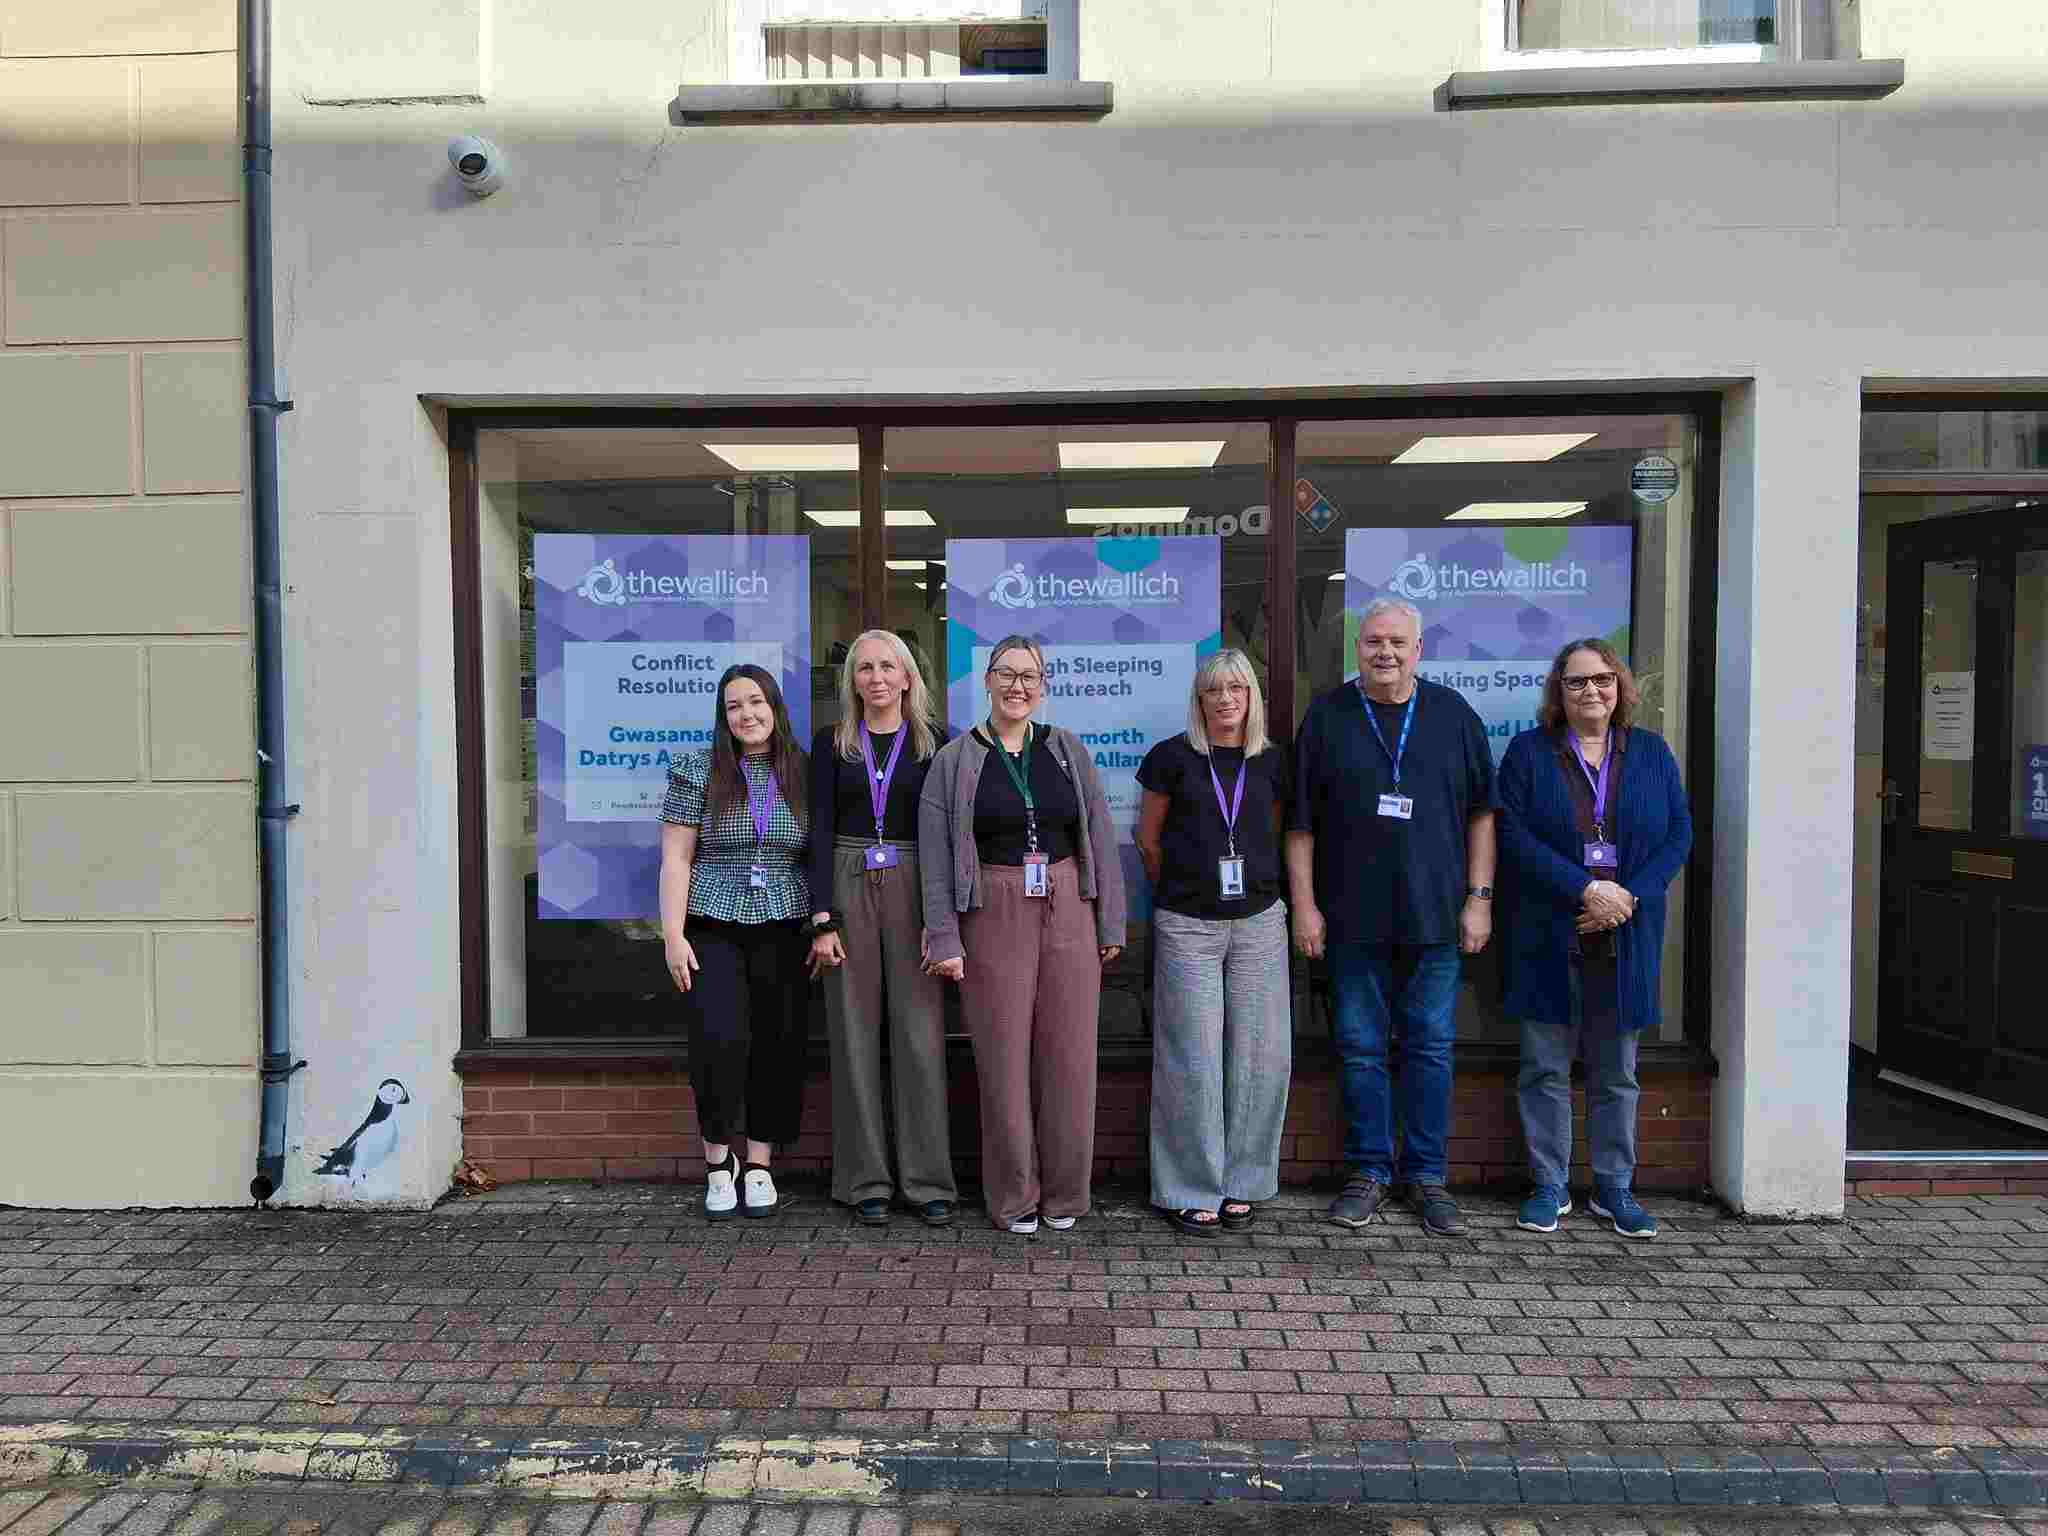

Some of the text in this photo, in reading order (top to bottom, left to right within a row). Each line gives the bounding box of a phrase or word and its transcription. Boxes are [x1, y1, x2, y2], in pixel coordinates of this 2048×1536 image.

[628, 568, 769, 595] thewallich
[1036, 571, 1179, 597] thewallich
[1438, 562, 1587, 588] thewallich
[631, 654, 716, 671] Conflict
[1073, 656, 1163, 676] Sleeping
[617, 677, 718, 694] Resolutio
[1493, 670, 1546, 691] Spac
[609, 727, 714, 743] Gwasanae
[1079, 728, 1144, 745] morth
[580, 750, 652, 770] Datrys
